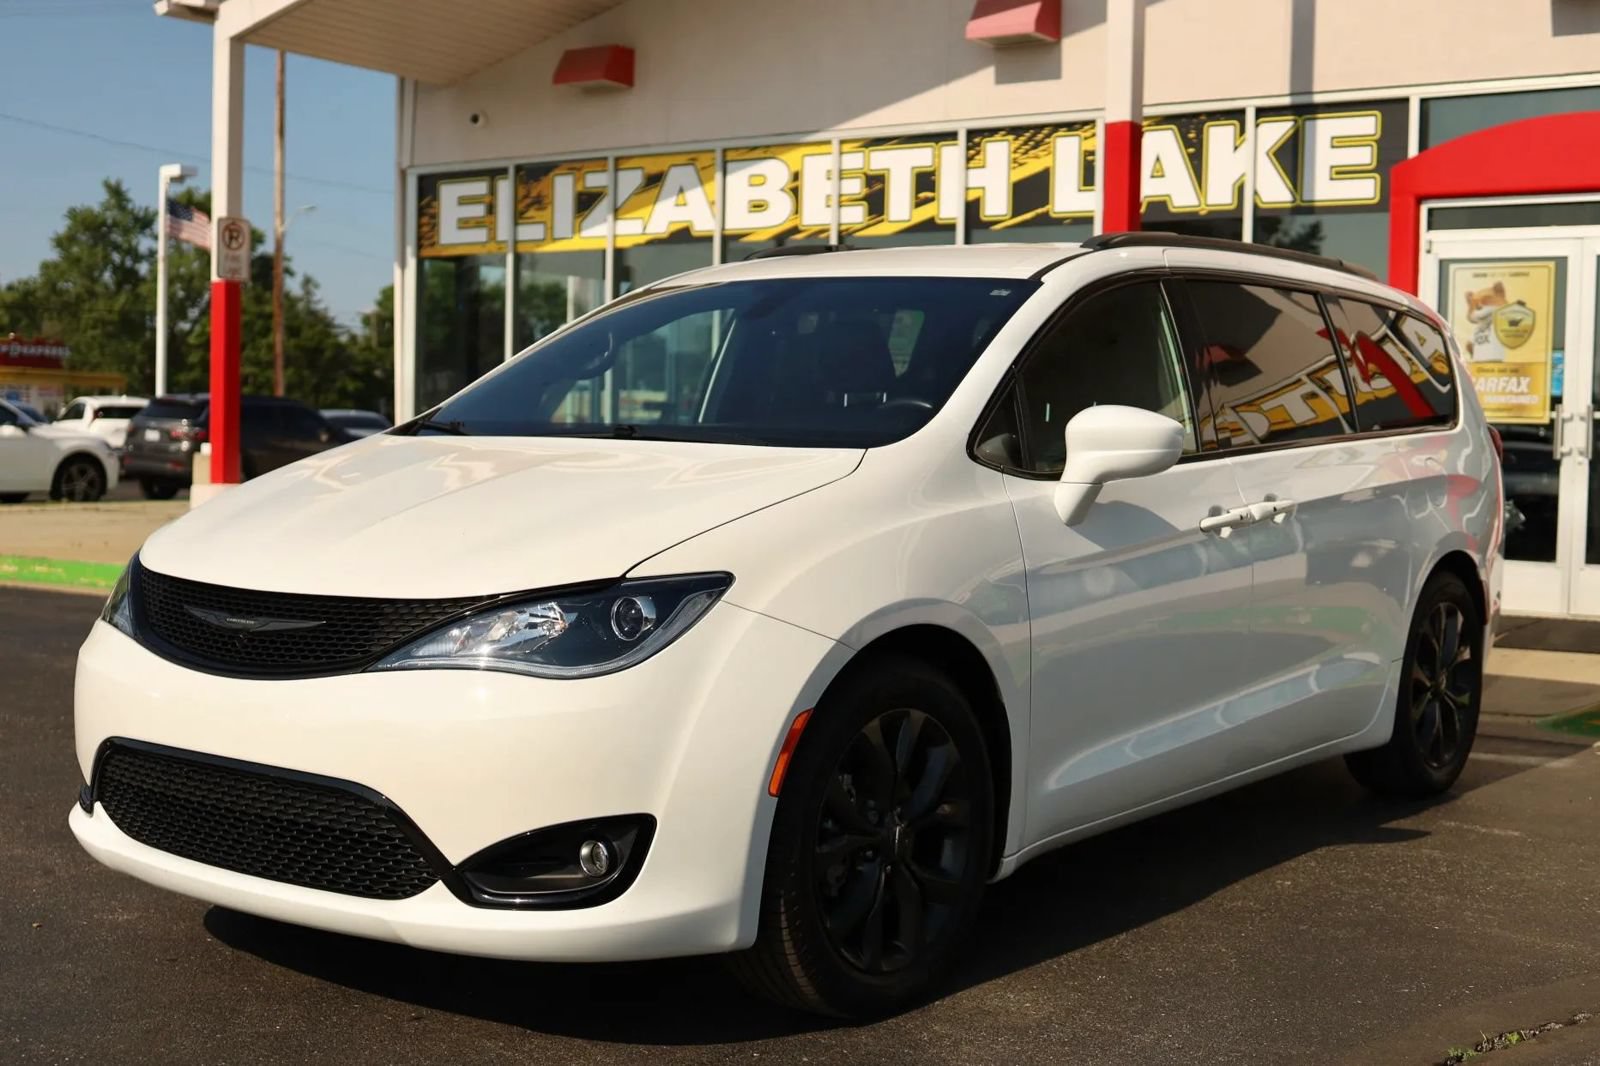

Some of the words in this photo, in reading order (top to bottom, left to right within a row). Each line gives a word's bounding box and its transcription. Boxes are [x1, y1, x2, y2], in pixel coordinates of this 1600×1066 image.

[437, 138, 1012, 246] ELIZABETH
[1049, 110, 1383, 218] LAKE
[1472, 376, 1531, 393] ARFAX
